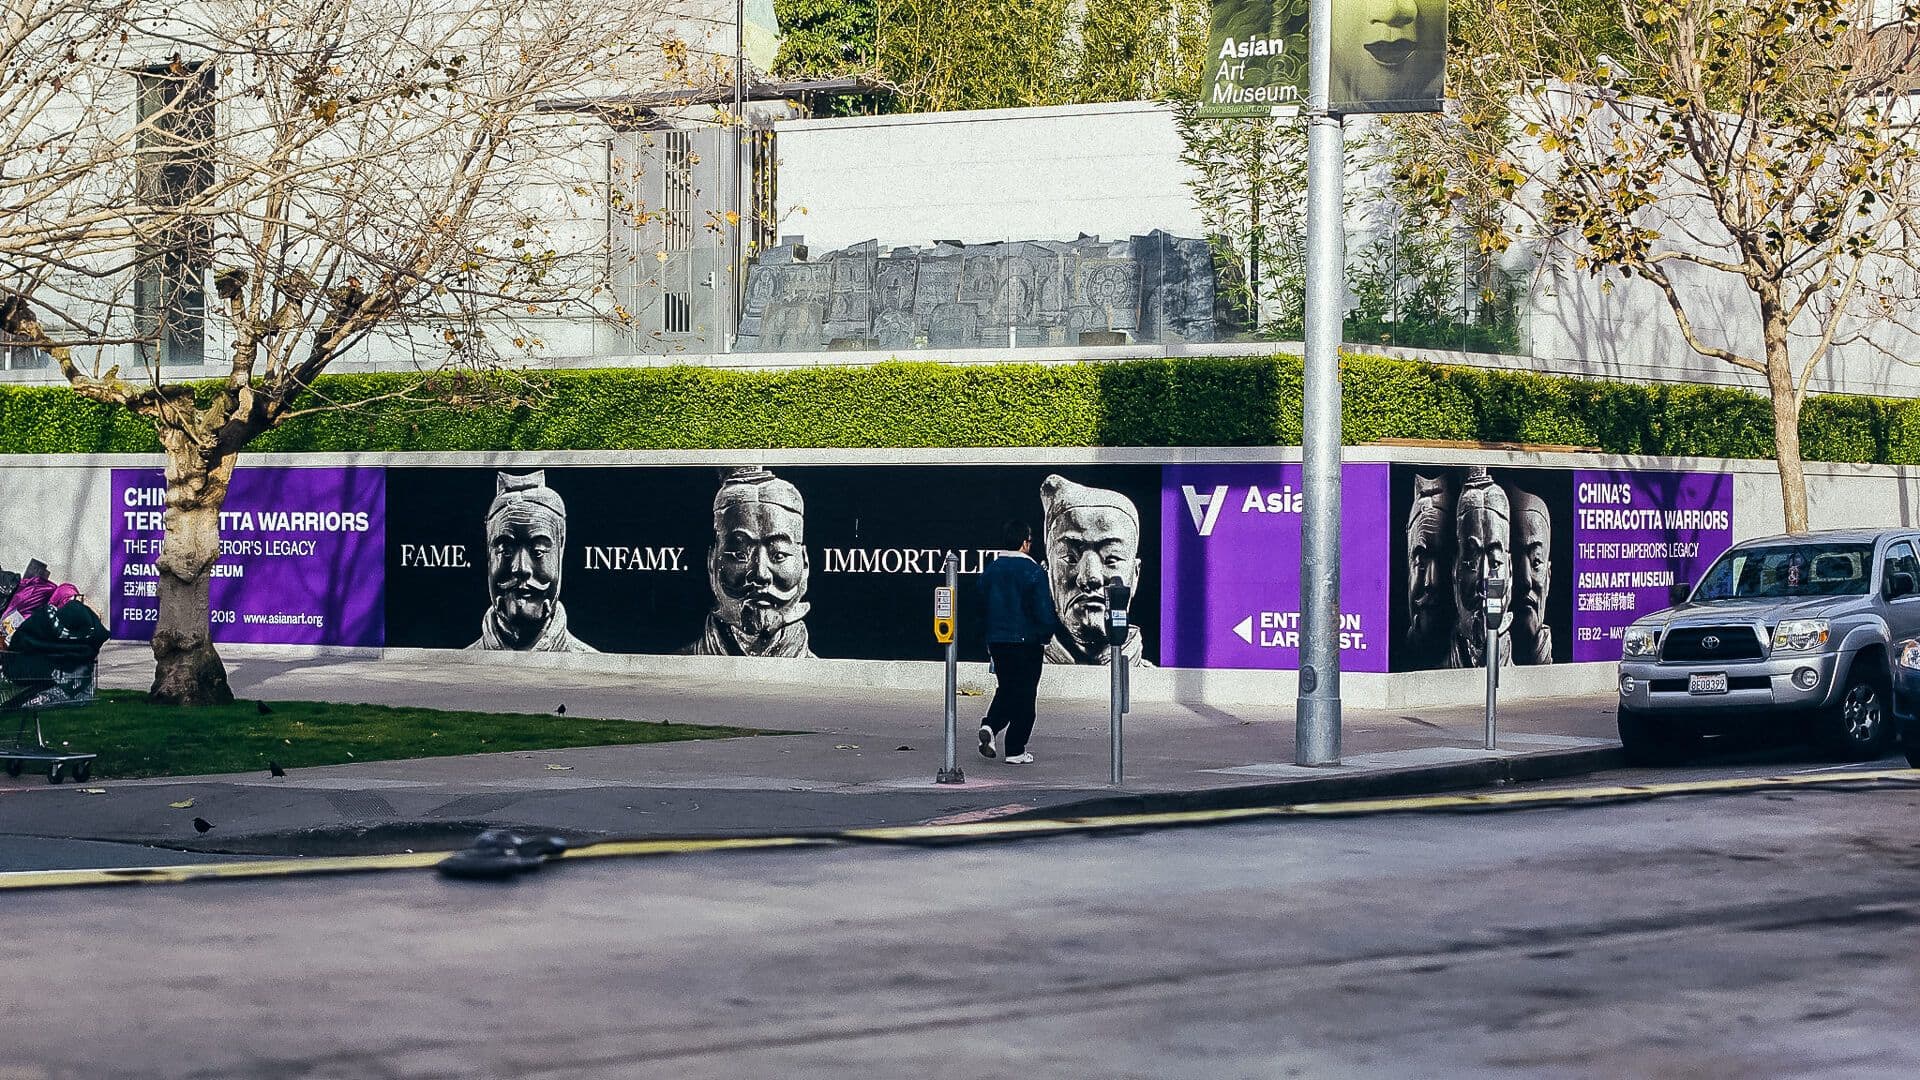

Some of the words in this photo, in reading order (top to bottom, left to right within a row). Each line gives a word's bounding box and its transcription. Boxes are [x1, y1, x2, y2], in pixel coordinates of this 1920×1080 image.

[1218, 35, 1284, 59] Asian
[1215, 60, 1245, 80] Art
[1212, 83, 1298, 103] Museum
[1241, 485, 1303, 513] Asia
[1578, 482, 1631, 504] CHINA'S
[258, 511, 369, 532] WARRIORS
[1578, 508, 1662, 530] TERRACOTTA
[1664, 510, 1729, 531] WARRIORS
[123, 539, 148, 554] THE
[266, 541, 317, 556] LEGACY
[1578, 543, 1595, 559] THE
[1596, 543, 1620, 559] FIRST
[1621, 543, 1667, 559] EMPEROR'S
[1669, 542, 1699, 558] LEGACY
[400, 543, 471, 568] FAME.
[584, 546, 689, 571] INFAMY.
[823, 548, 1000, 574] IMMORTALIT
[123, 563, 160, 576] ASIAN
[1578, 571, 1609, 589] ASIAN
[1610, 571, 1631, 588] ART
[1631, 571, 1674, 587] MUSEUM
[123, 608, 143, 621] FEB
[145, 609, 158, 621] 22
[211, 610, 236, 624] 2013
[243, 611, 323, 628] www.asianart.org
[1578, 627, 1591, 641] FEB
[1592, 627, 1602, 641] 22
[1609, 626, 1624, 640] MAY
